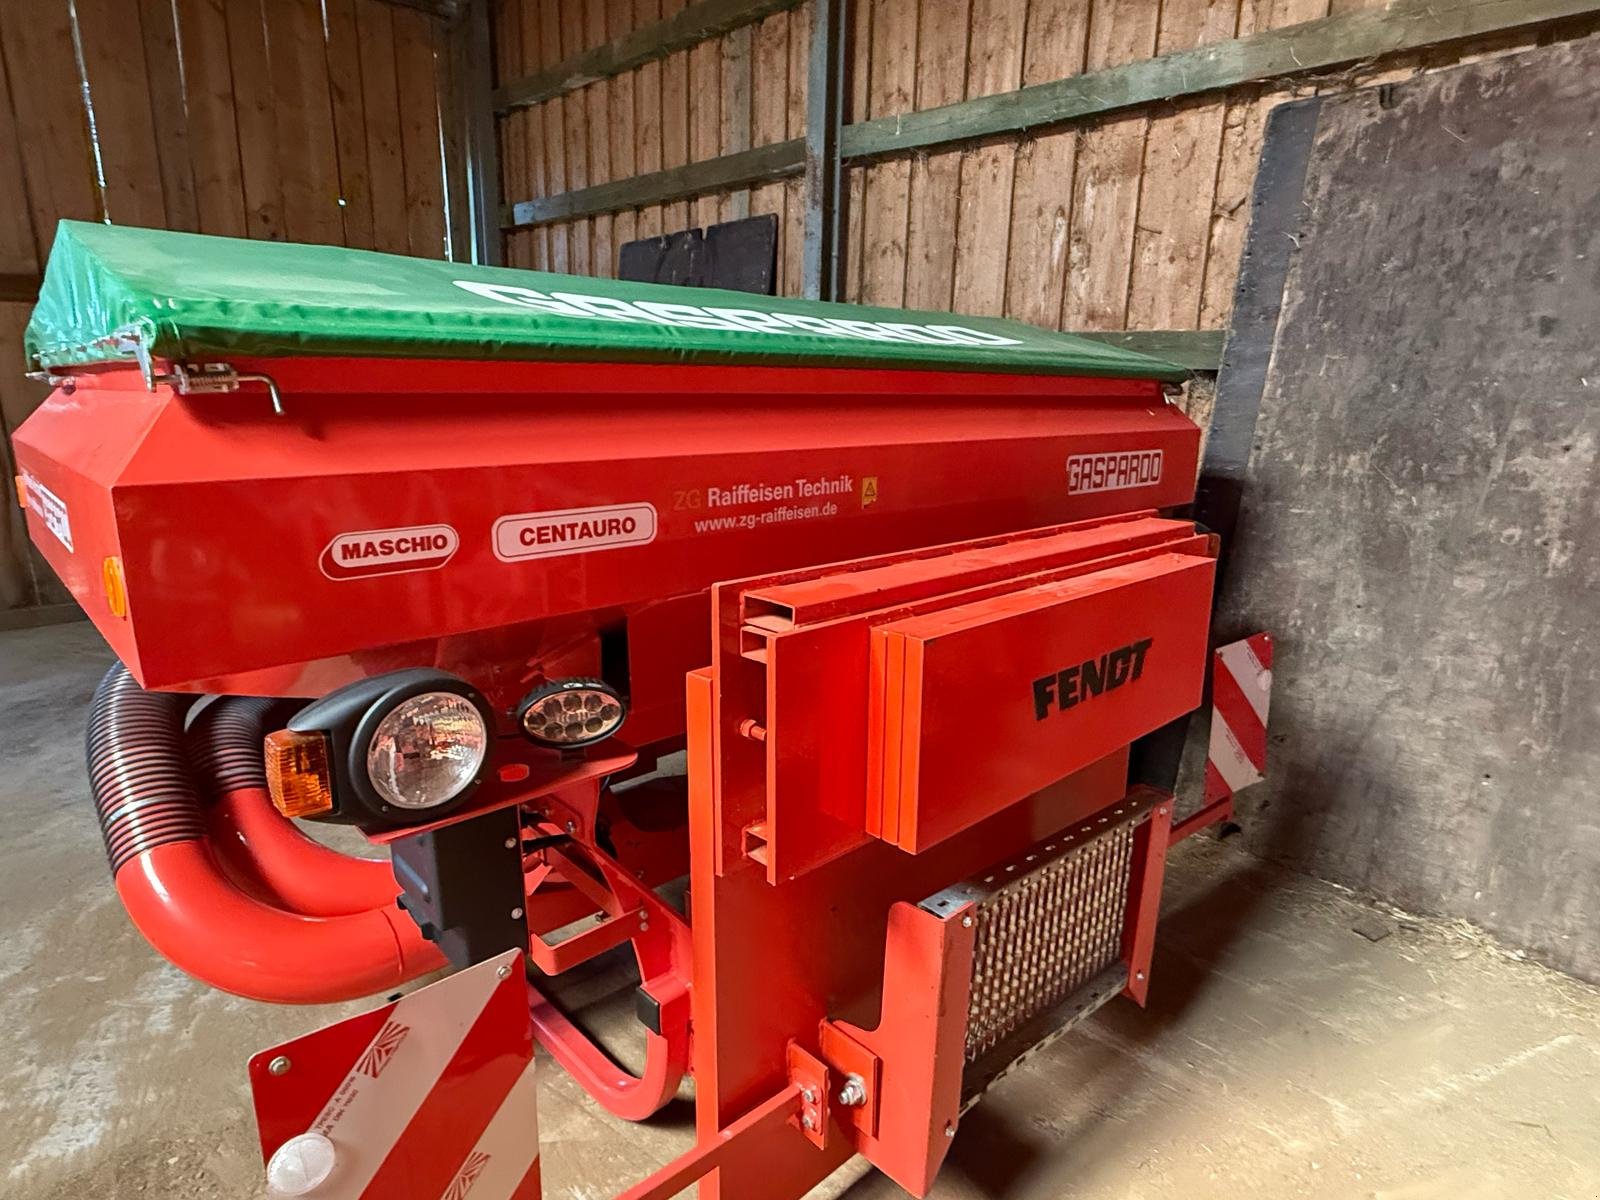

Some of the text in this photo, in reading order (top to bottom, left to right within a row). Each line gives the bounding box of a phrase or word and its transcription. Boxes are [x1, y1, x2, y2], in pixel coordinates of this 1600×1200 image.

[452, 280, 1024, 346] GASPARDO
[1068, 452, 1162, 492] GASPARDO
[673, 475, 853, 511] ZG Raiffeisen Technik
[519, 516, 637, 547] CENTAURO
[694, 501, 838, 533] www.zg-raiffeisen.de
[341, 533, 448, 561] MASCHIO
[1032, 637, 1153, 721] FENDT
